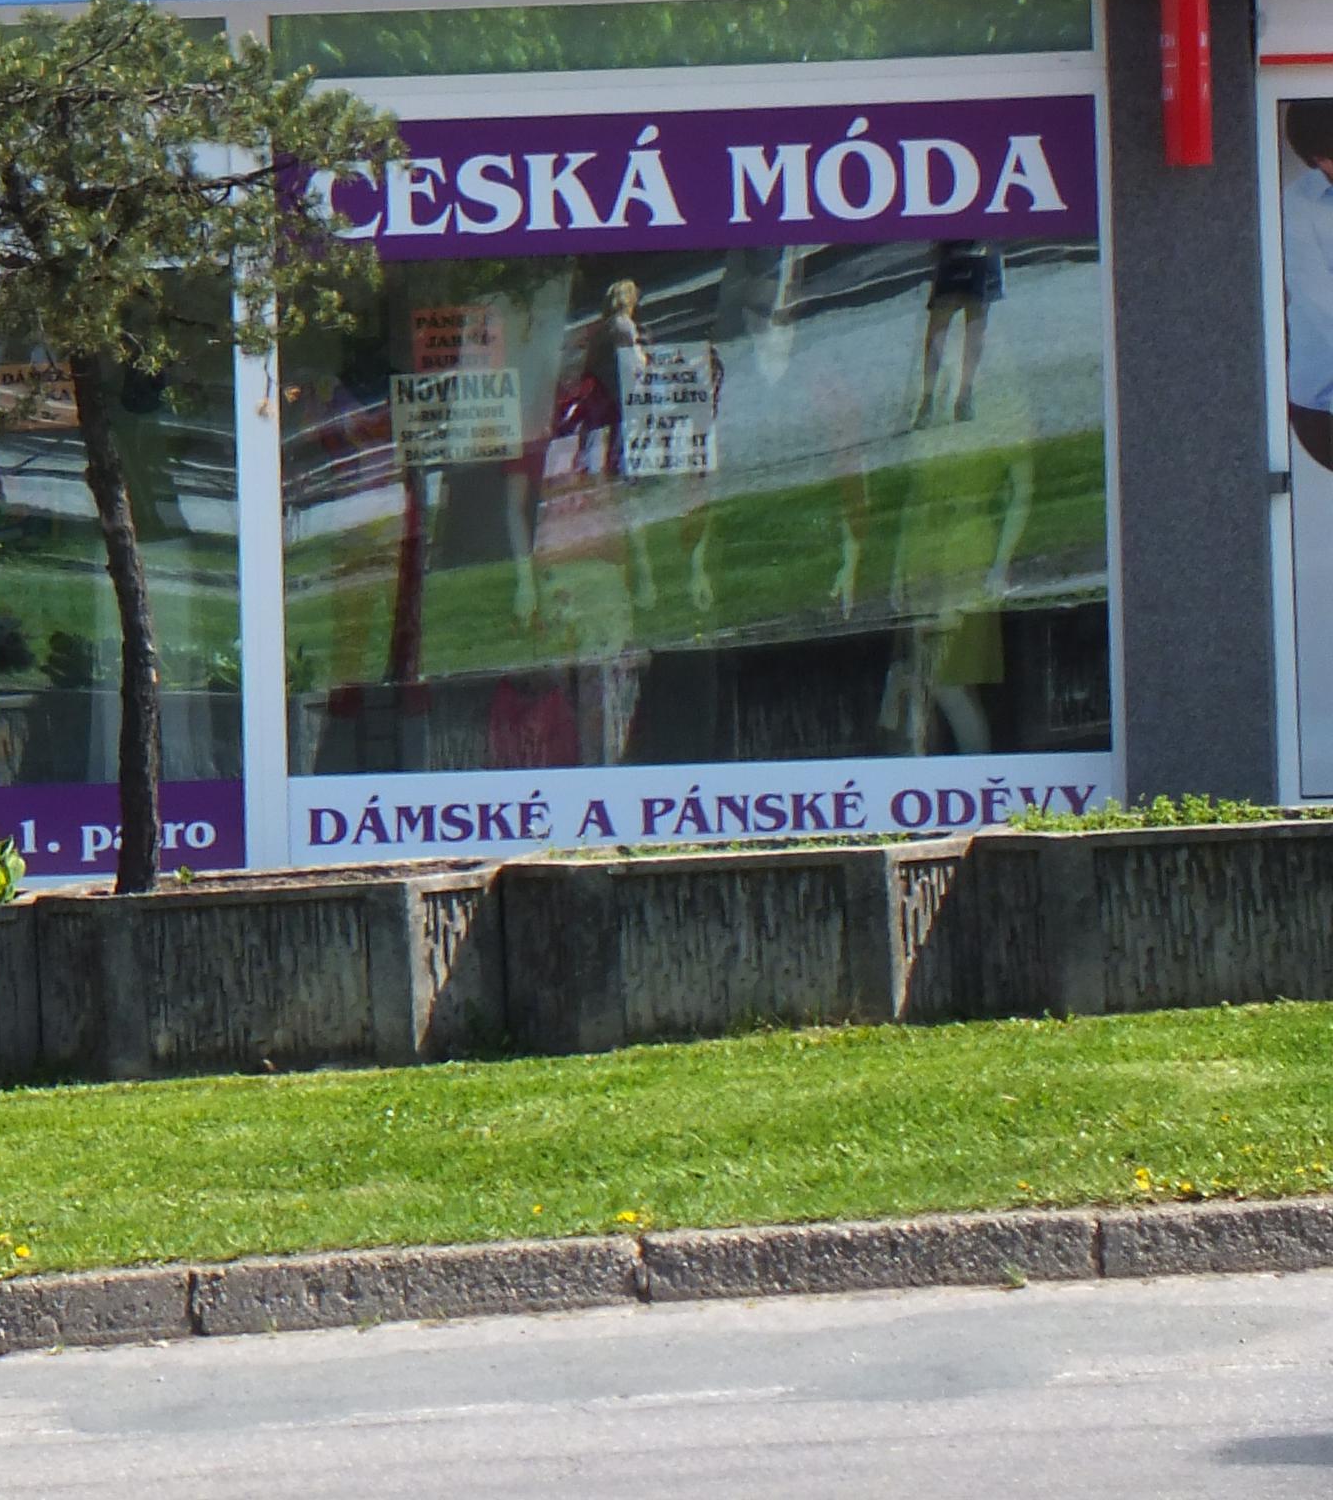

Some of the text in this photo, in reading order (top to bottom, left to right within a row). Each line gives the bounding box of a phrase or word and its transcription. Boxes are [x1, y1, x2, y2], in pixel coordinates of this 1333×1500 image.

[727, 116, 1069, 223] MÓDA
[396, 373, 516, 405] NOVINKA
[307, 790, 552, 846] DÁMSKÉ
[576, 800, 617, 838] A
[640, 779, 868, 836] PÁNSKÉ
[80, 821, 218, 863] pro
